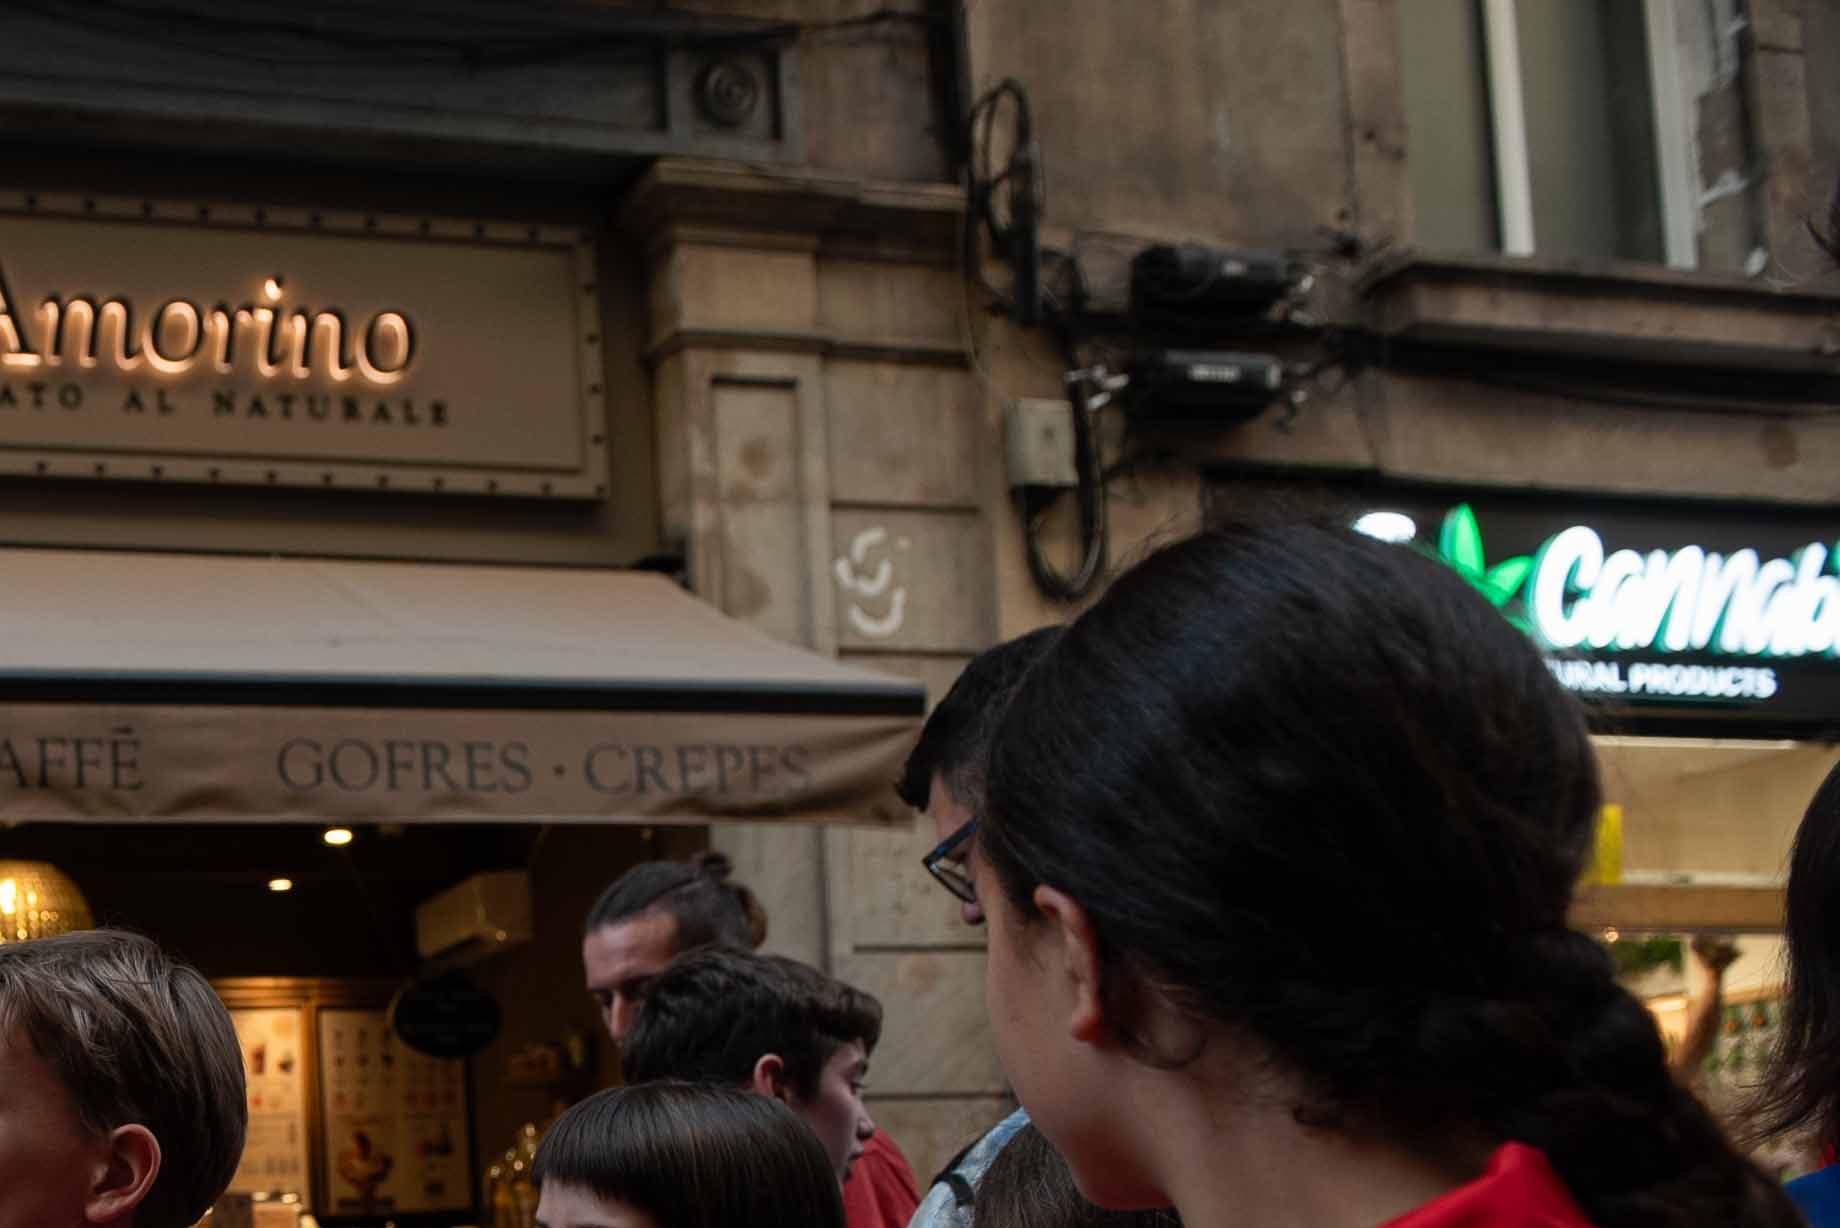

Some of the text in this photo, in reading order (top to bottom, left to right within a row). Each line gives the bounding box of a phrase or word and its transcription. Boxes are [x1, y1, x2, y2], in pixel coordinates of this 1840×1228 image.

[124, 385, 174, 415] AL
[212, 389, 450, 428] NATURALE
[1628, 661, 1777, 698] PRODUCTS
[276, 738, 532, 794] GOFRES
[584, 743, 812, 796] CREPES
